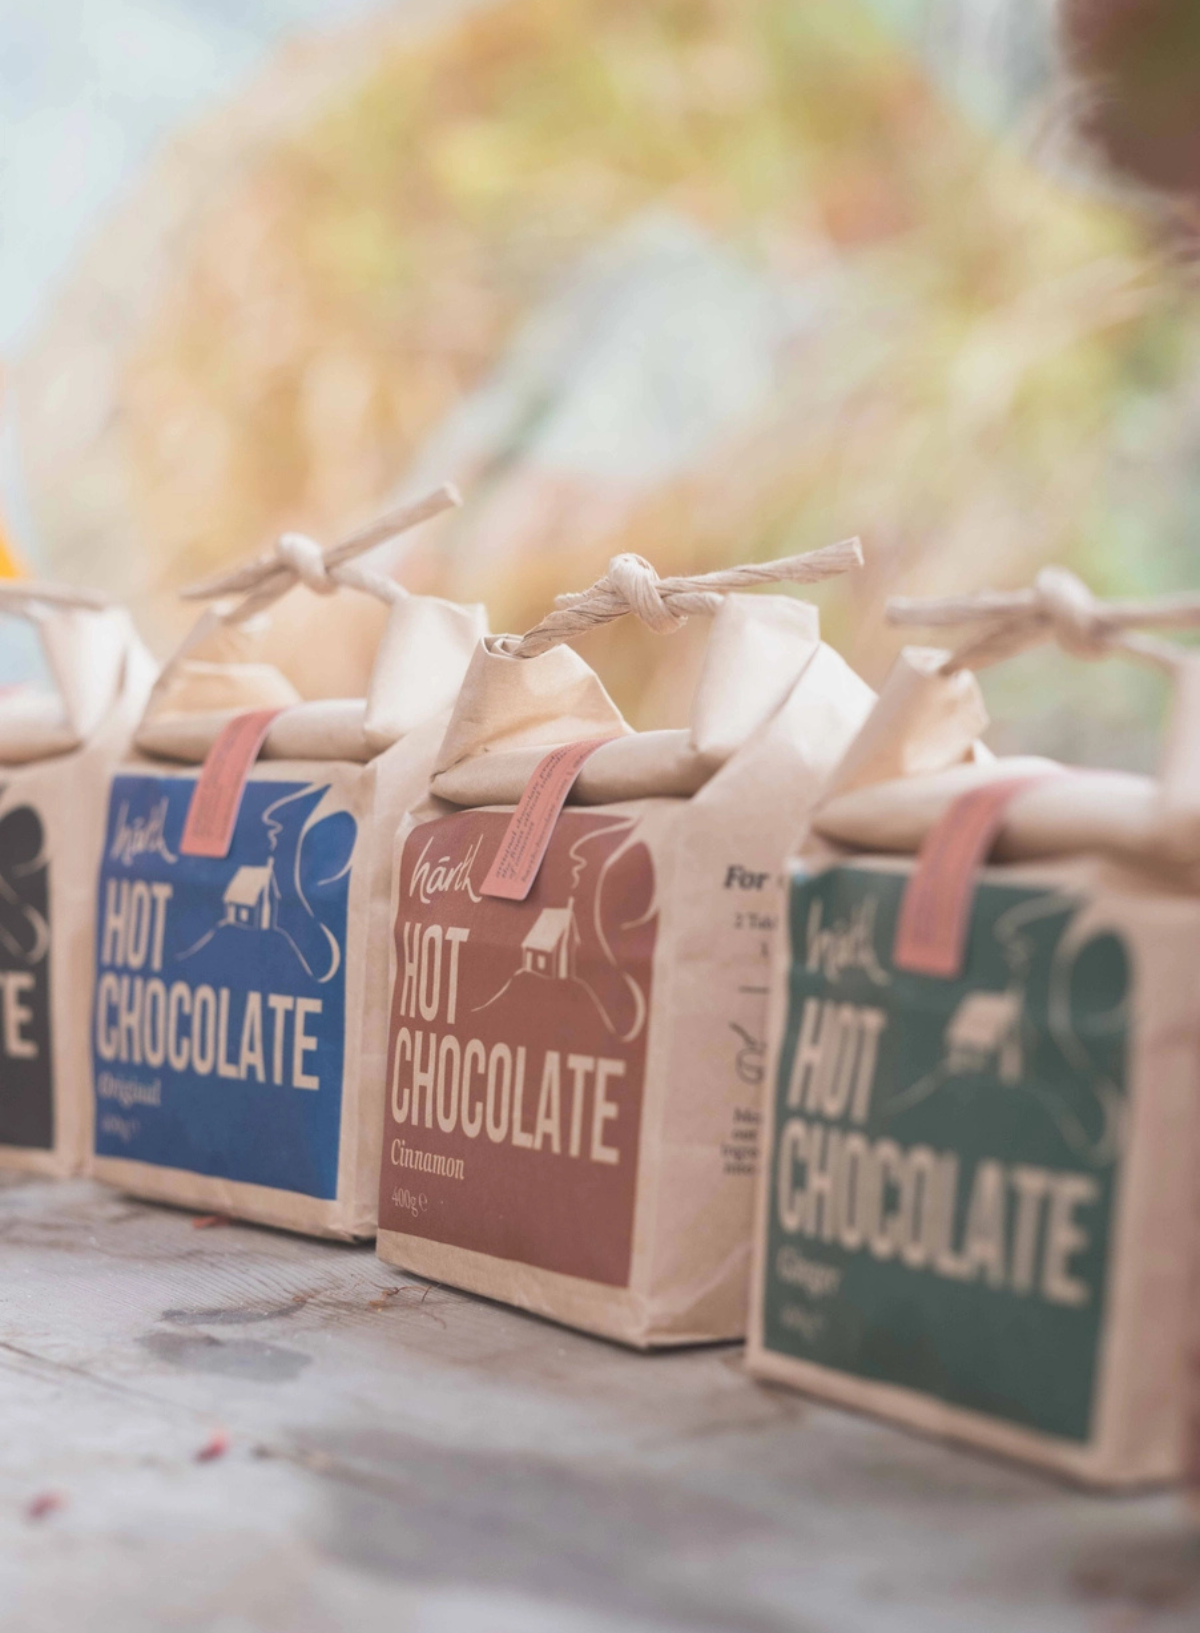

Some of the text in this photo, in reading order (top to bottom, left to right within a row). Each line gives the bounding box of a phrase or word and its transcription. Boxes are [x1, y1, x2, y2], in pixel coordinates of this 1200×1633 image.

[102, 878, 173, 972] HOT
[723, 864, 769, 891] For
[401, 921, 470, 1025] HOT
[99, 973, 322, 1090] CHOCOLATE
[789, 997, 885, 1123] HOT
[391, 1026, 626, 1165] CHOCOLATE
[390, 1138, 465, 1180] Cinnamon
[778, 1117, 1096, 1308] CHOCOLATE
